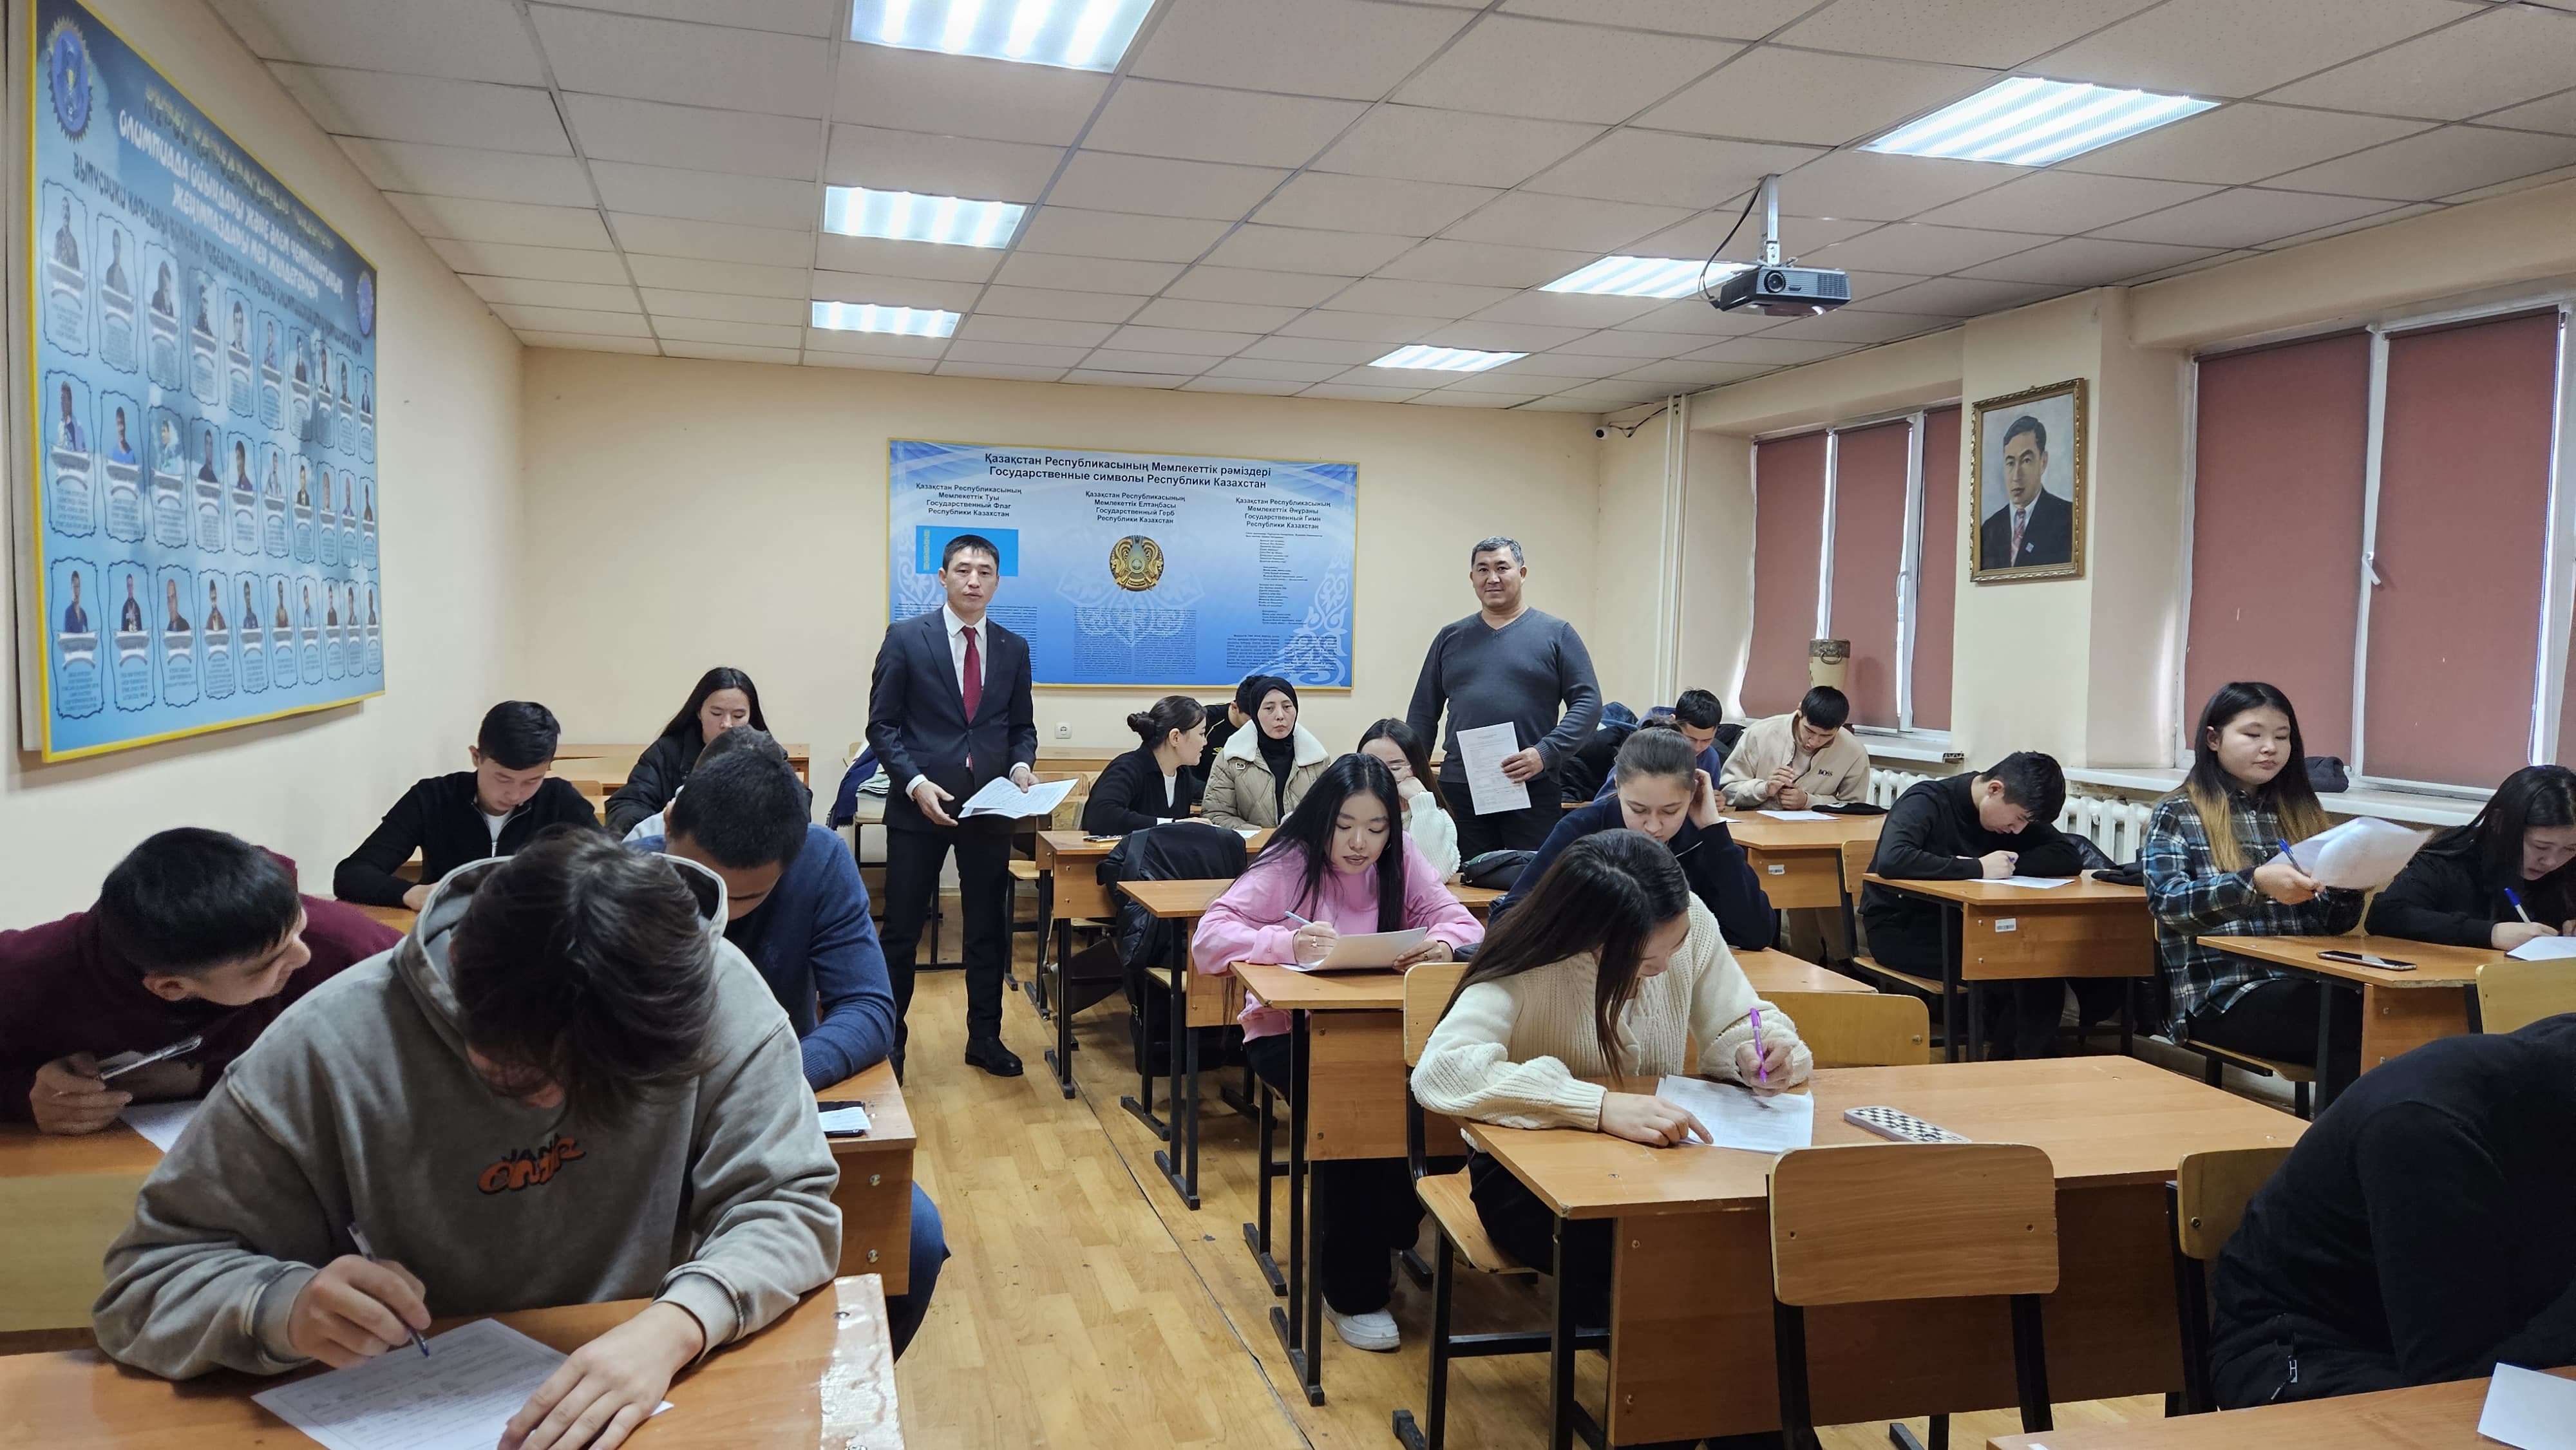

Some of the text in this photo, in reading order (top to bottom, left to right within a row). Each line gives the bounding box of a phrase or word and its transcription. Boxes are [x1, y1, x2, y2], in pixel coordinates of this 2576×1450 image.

[119, 109, 189, 182] ОЛИМПИАДА
[191, 162, 244, 222] ОЙЫНДАРЫ
[245, 205, 269, 241] ЖӘНЕ
[128, 191, 167, 236] КАФЕДРЫ
[985, 453, 1271, 478] Қазақстан Республикасының Мемлекеттік рәміздері
[989, 466, 1267, 489] Государственные символы Республики Казахстан
[916, 483, 1022, 494] Қазақстан Республикасының
[938, 492, 983, 500] Мемлекеттік
[1121, 493, 1186, 502] Республикасының
[927, 500, 991, 508] Государственный
[1270, 499, 1331, 507] Республикасының
[1096, 507, 1157, 516] Государственный
[1244, 513, 1303, 522] Государственный
